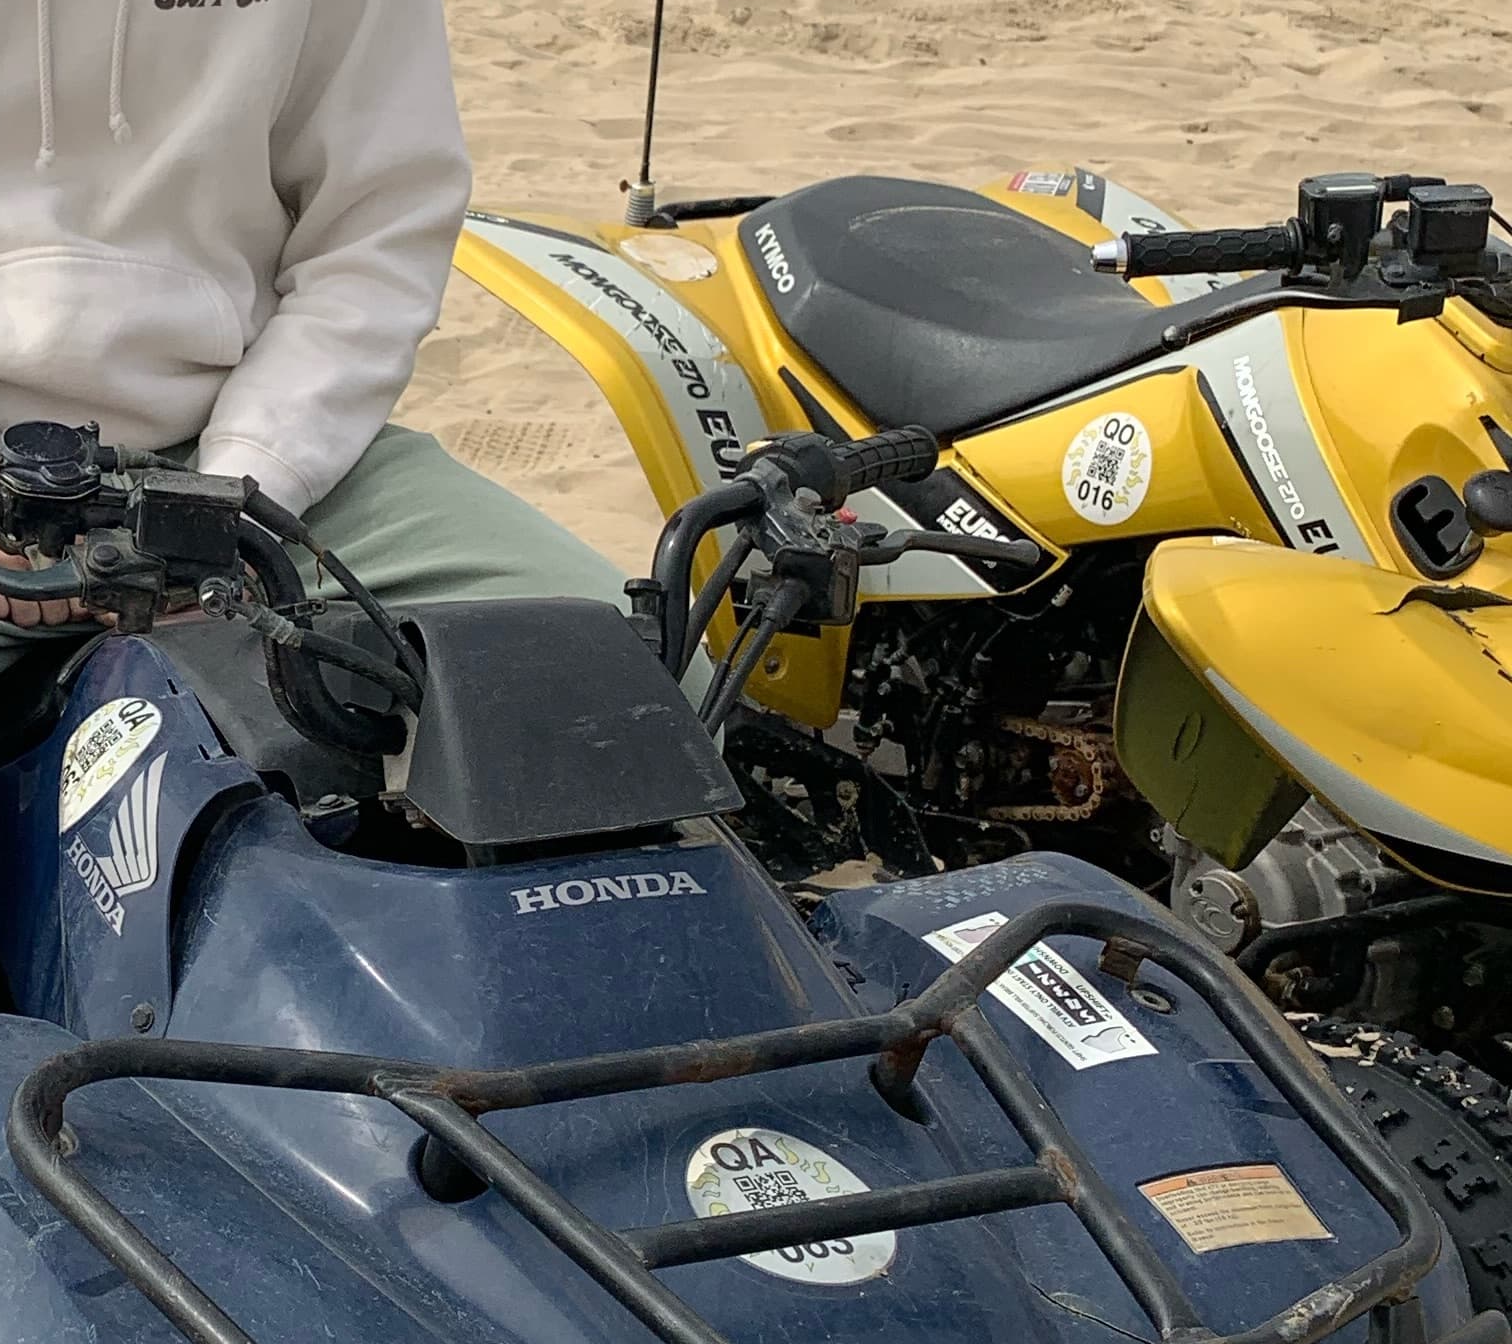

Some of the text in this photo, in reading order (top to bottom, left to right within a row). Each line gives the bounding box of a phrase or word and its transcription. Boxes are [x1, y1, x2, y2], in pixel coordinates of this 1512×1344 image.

[754, 222, 796, 294] KYMCO
[672, 358, 711, 399] 270
[1233, 355, 1305, 520] MONGOOSE 270
[1076, 479, 1115, 512] 016
[117, 699, 155, 732] QA
[64, 836, 126, 938] HONDA
[510, 871, 708, 915] HONDA
[1031, 988, 1049, 1004] ONLY
[710, 1137, 787, 1172] QA
